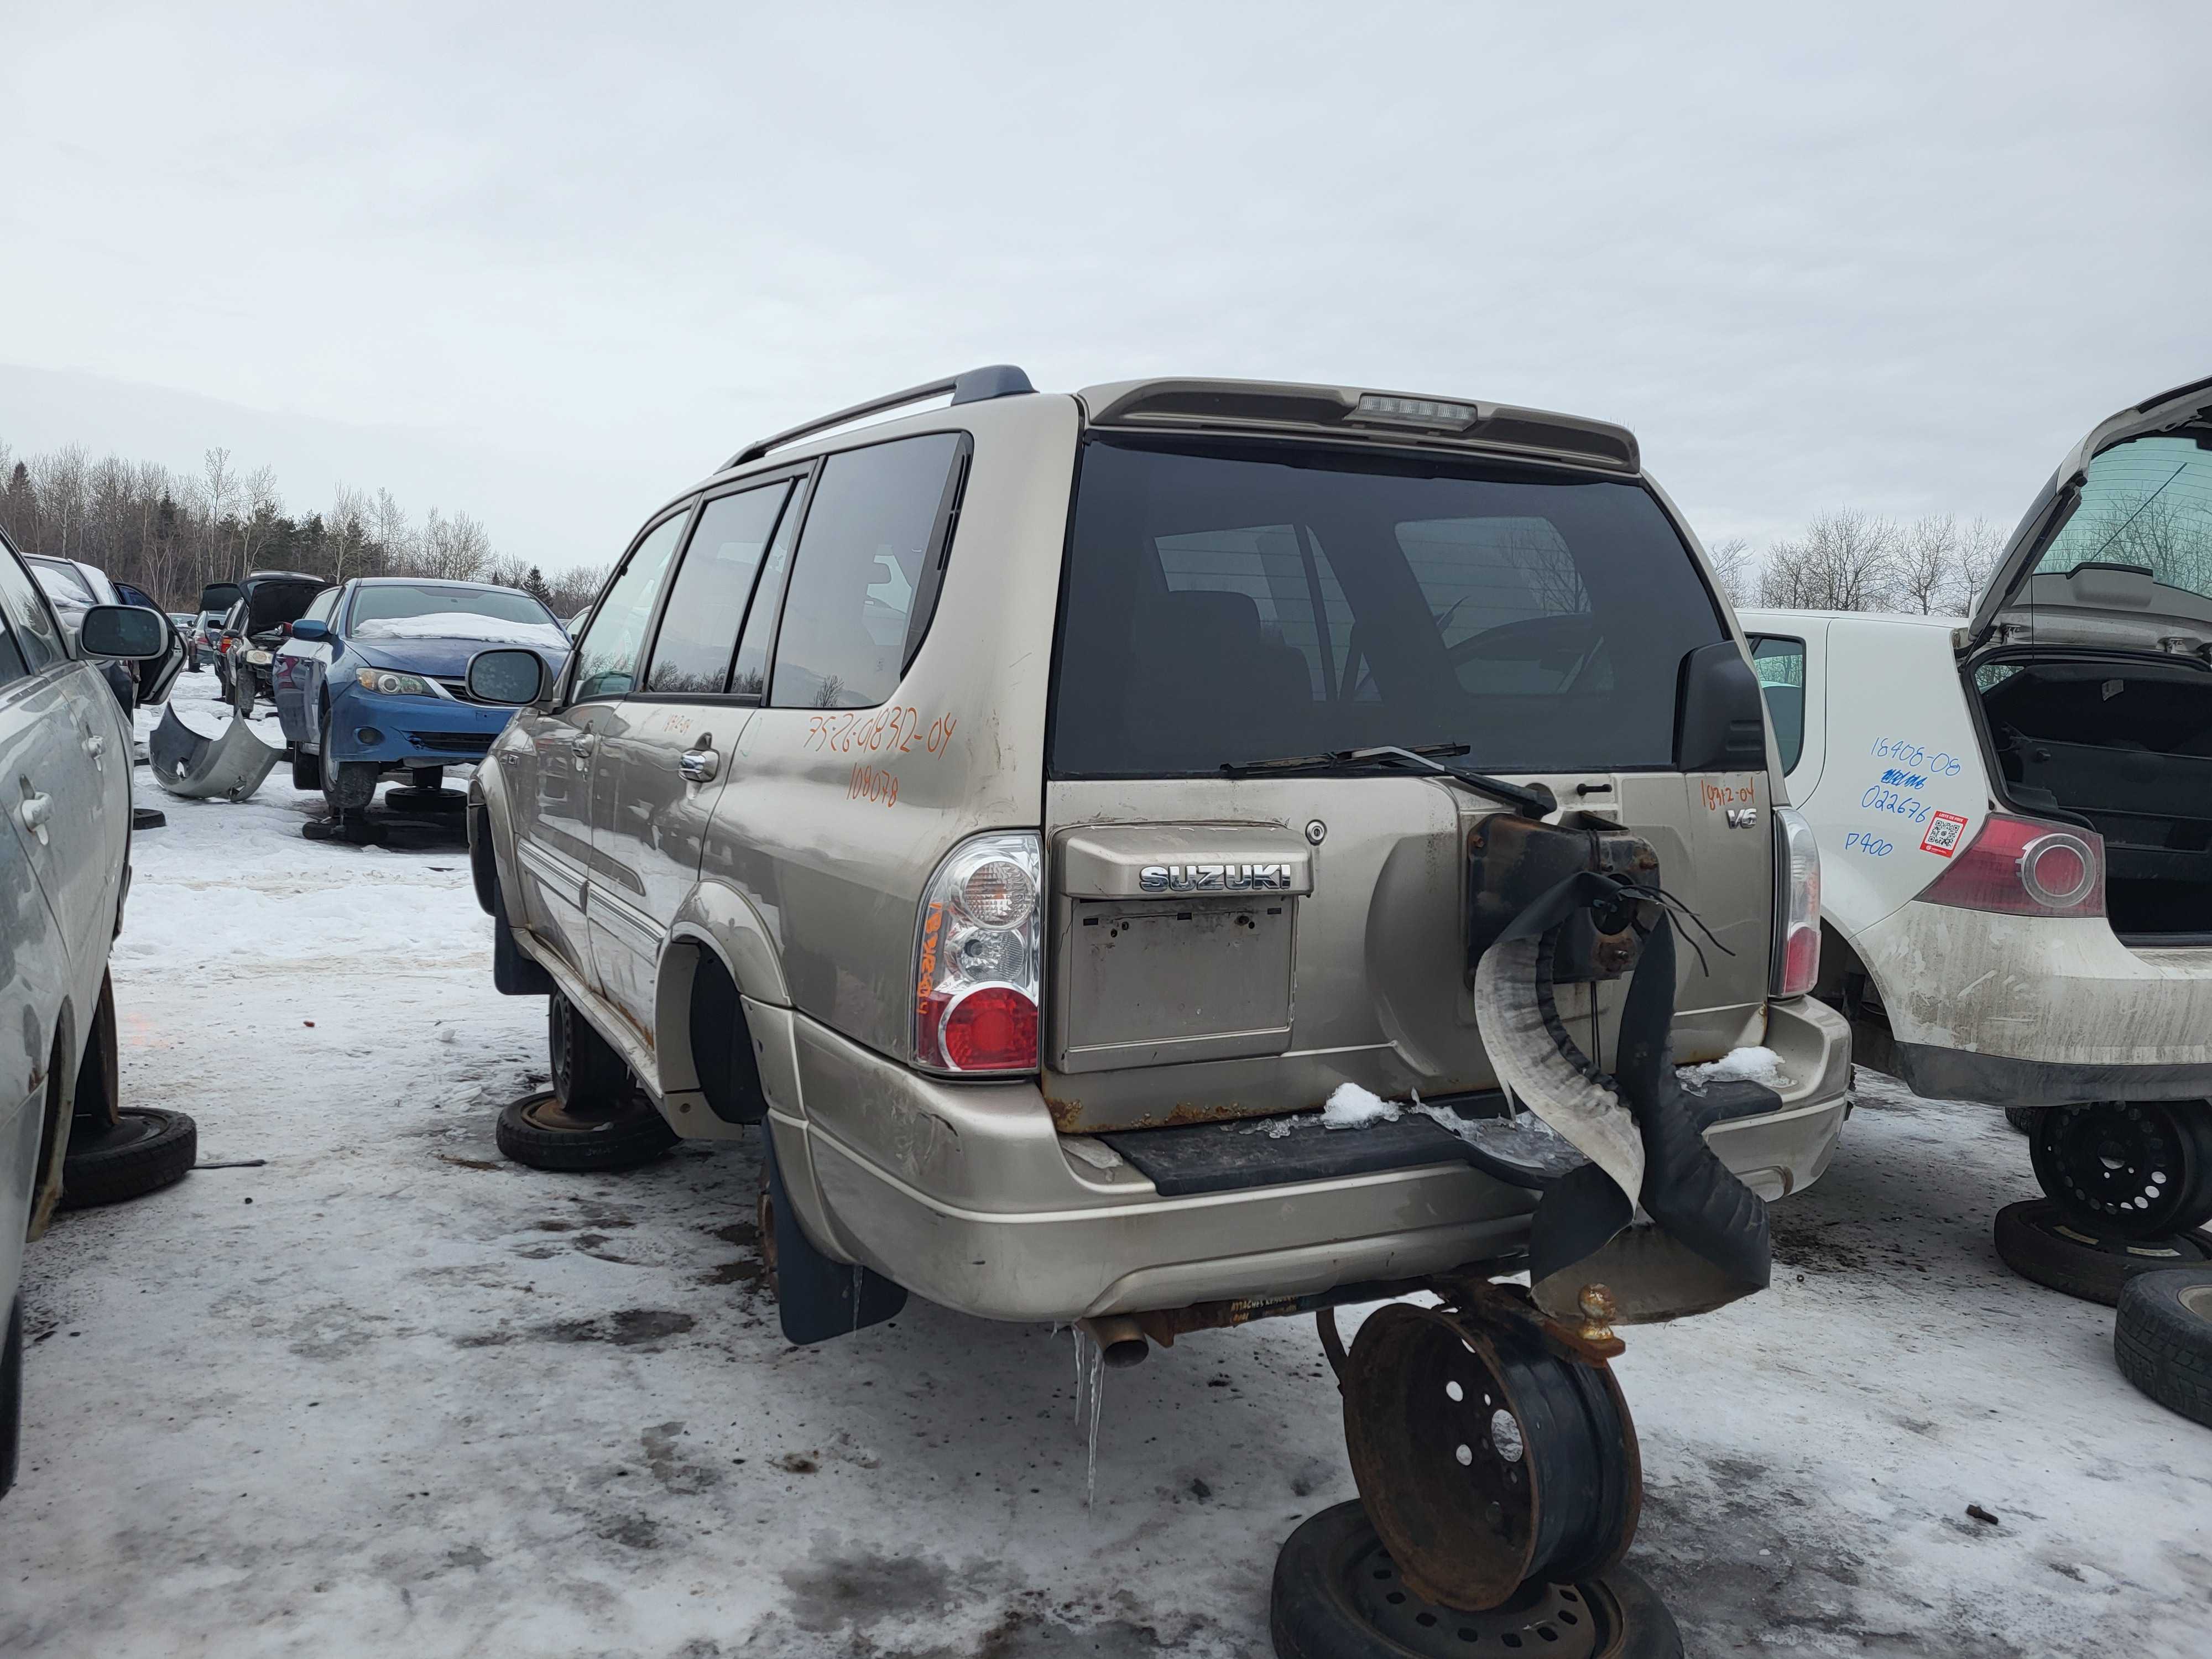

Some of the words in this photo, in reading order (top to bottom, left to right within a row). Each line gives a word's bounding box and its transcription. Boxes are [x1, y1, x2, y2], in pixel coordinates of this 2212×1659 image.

[1861, 785, 1931, 823] 022676
[1726, 808, 1757, 829] V6
[1845, 832, 1893, 857] P400
[1139, 864, 1292, 893] SUZUKI
